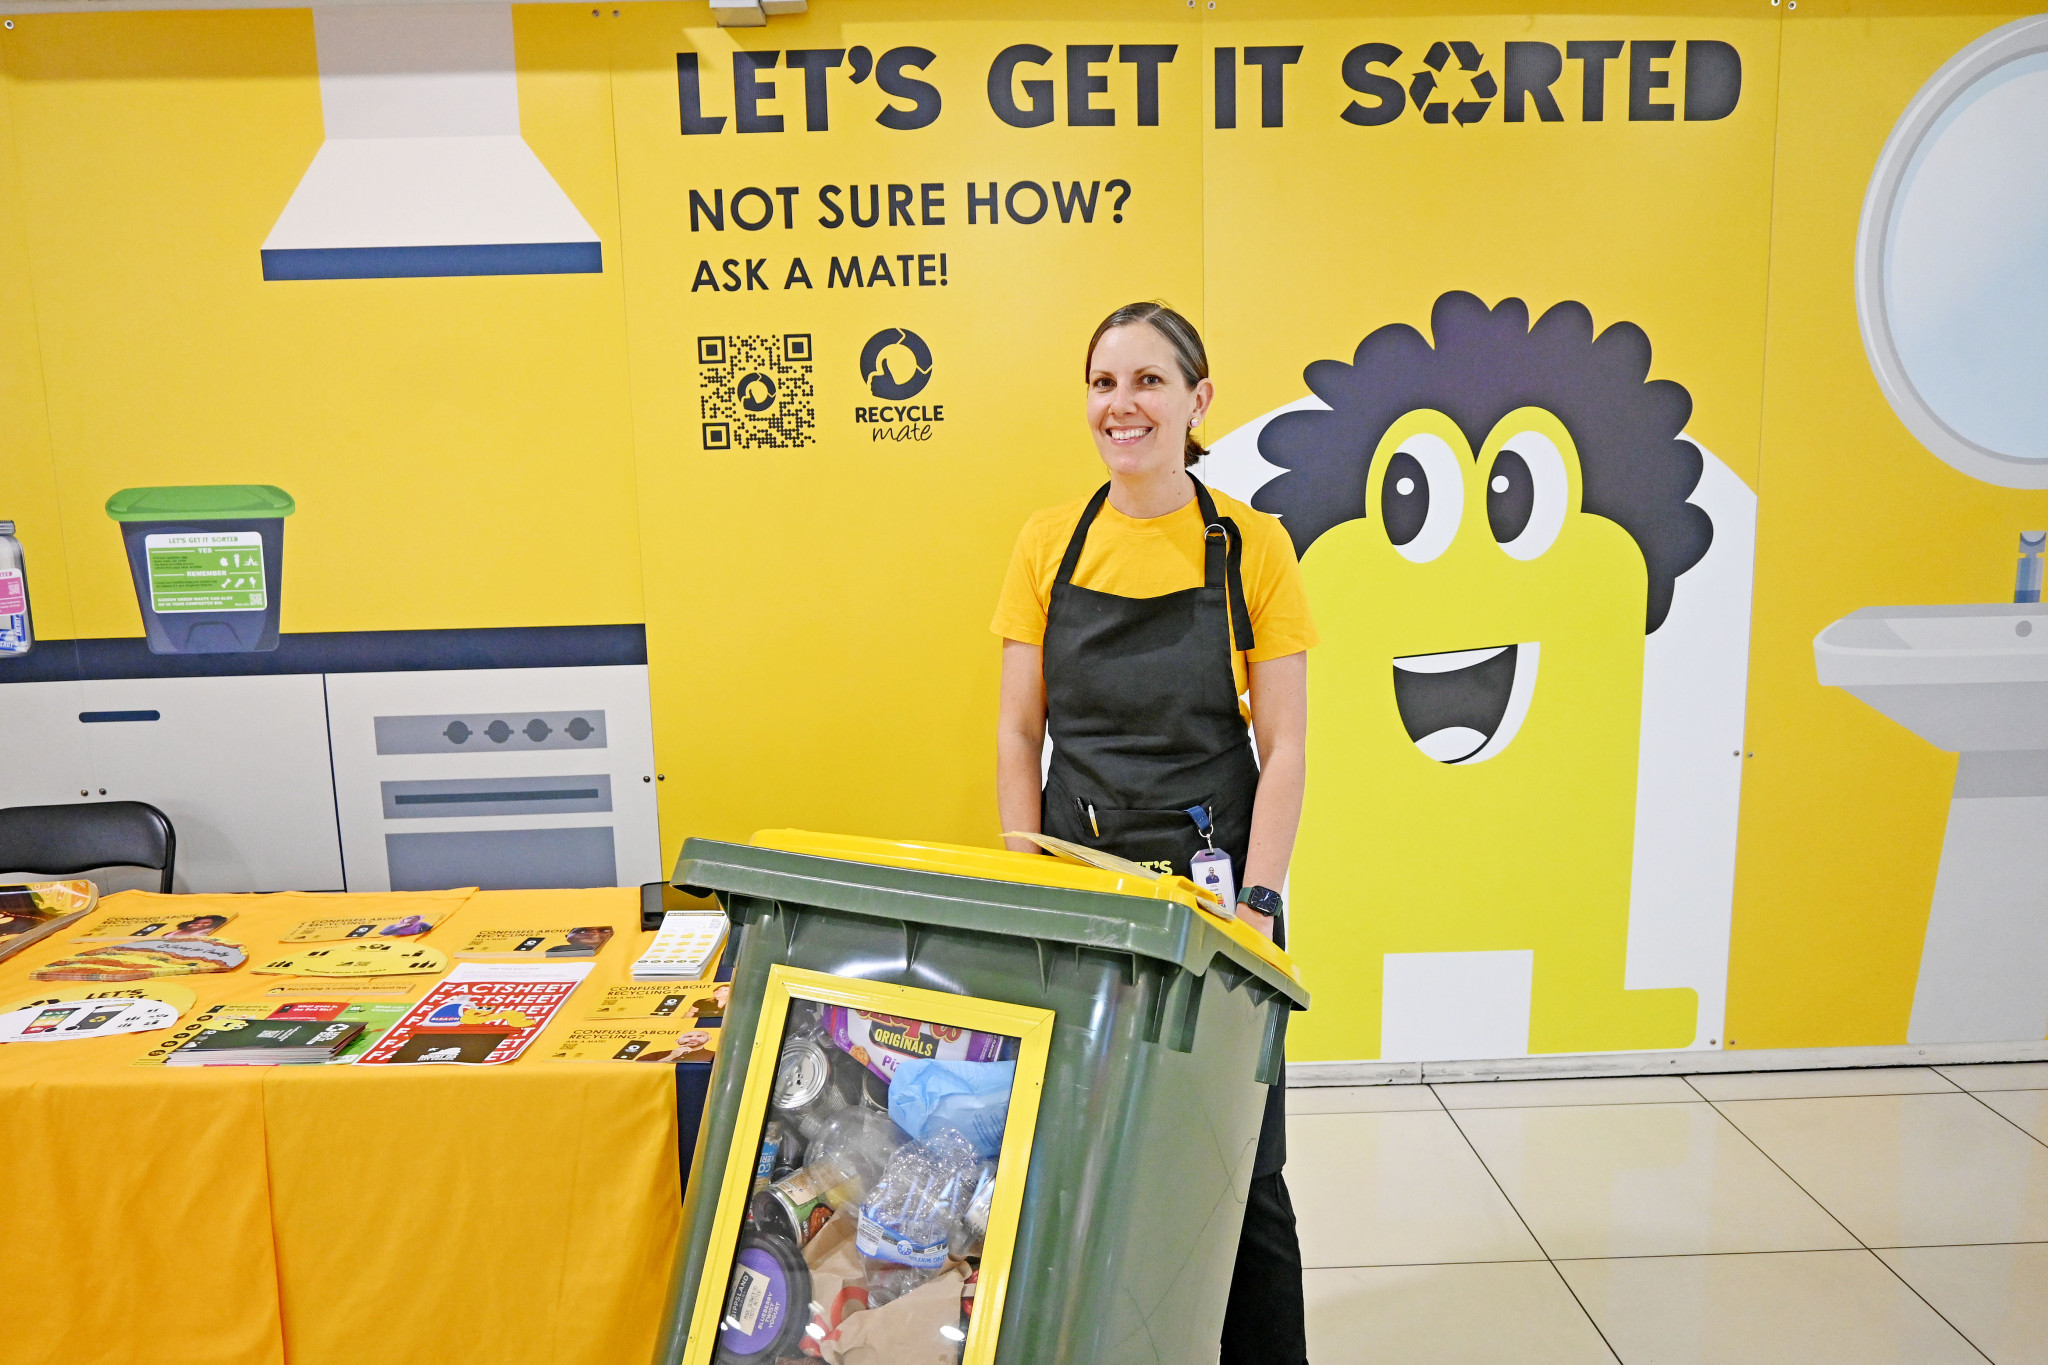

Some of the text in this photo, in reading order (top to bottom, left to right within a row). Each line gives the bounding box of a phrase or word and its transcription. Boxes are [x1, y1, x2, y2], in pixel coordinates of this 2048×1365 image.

[677, 45, 942, 135] LET'S
[987, 44, 1178, 128] GET
[1214, 45, 1304, 129] IT
[689, 178, 1131, 232] NOT SURE HOW?
[691, 253, 948, 292] ASK A MATE!
[855, 405, 944, 423] RECYCLE
[873, 423, 932, 442] mate
[86, 989, 144, 999] LET'S
[439, 983, 572, 993] FACTSHEET
[874, 1028, 933, 1057] ORIGINALS
[758, 1292, 773, 1330] BLUEBERRY
[765, 1303, 774, 1322] TWIST
[768, 1302, 780, 1328] YOGURT
